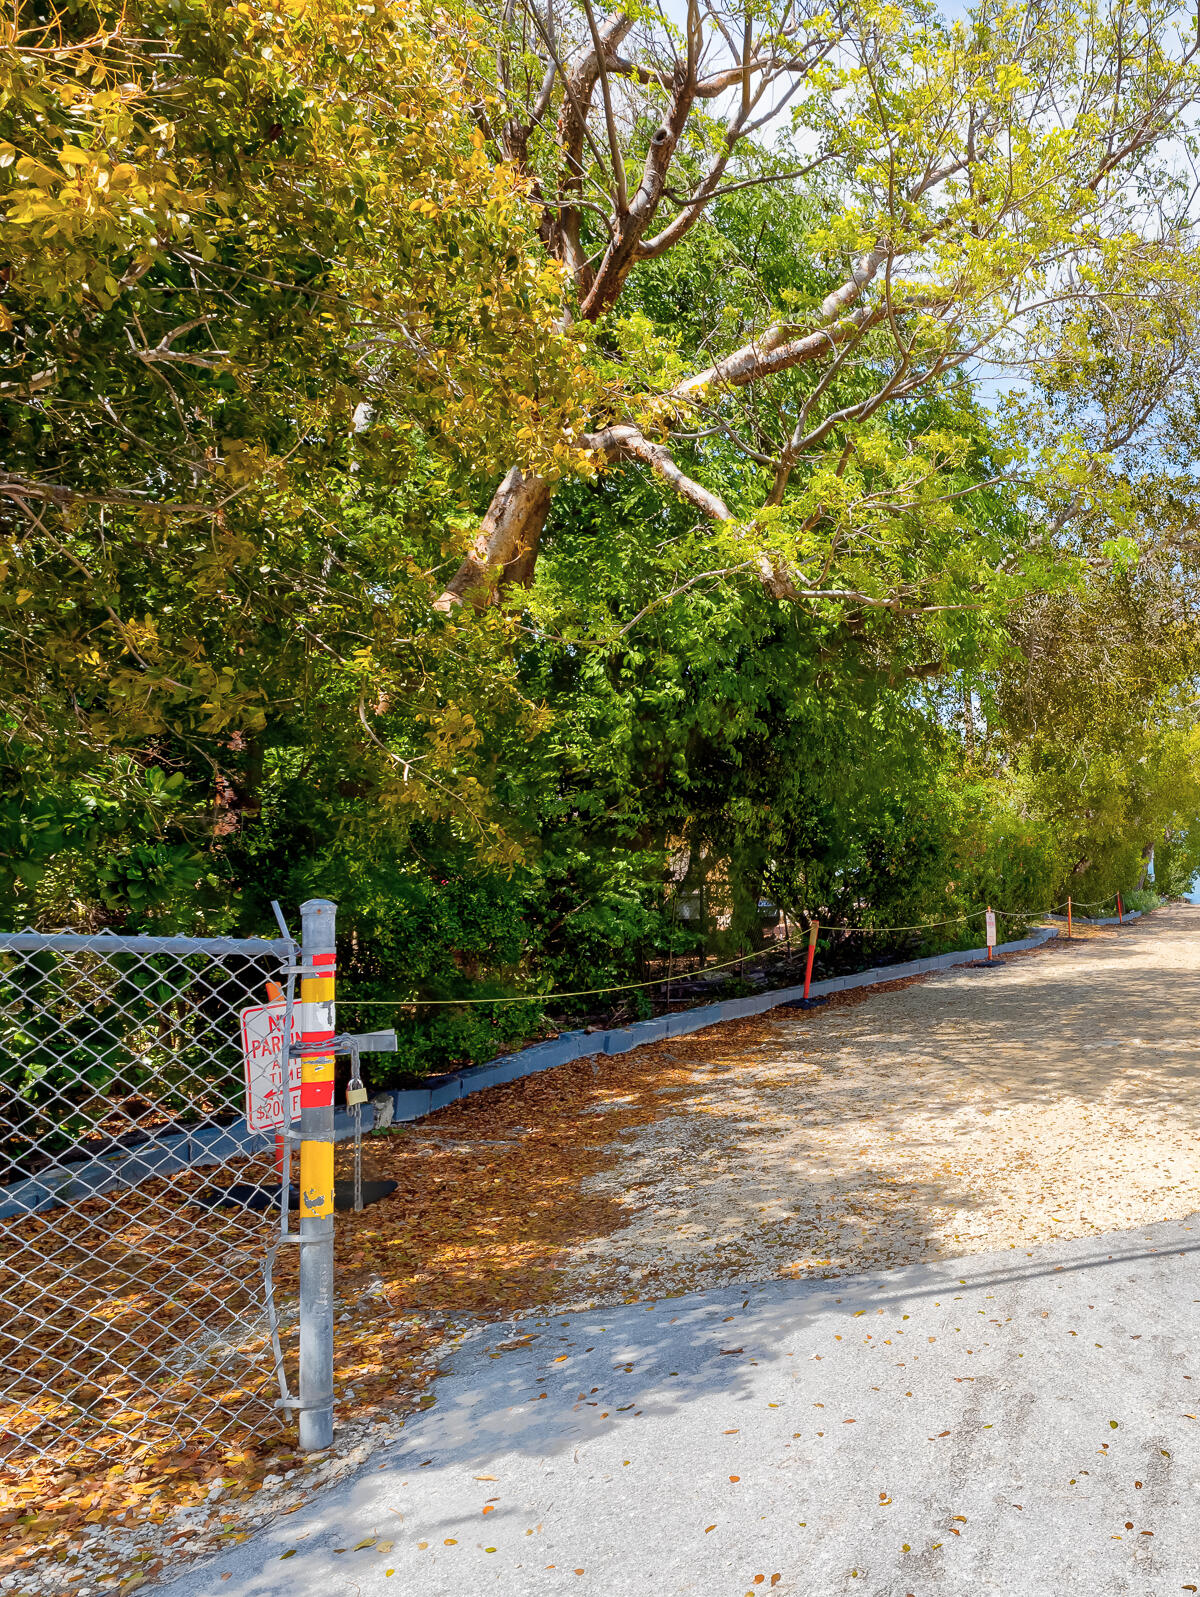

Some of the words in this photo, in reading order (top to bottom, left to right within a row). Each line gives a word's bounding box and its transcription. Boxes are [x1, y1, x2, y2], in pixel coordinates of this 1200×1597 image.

[268, 1015, 294, 1033] NO
[252, 1031, 302, 1059] PARIN
[256, 1100, 287, 1120] $20
